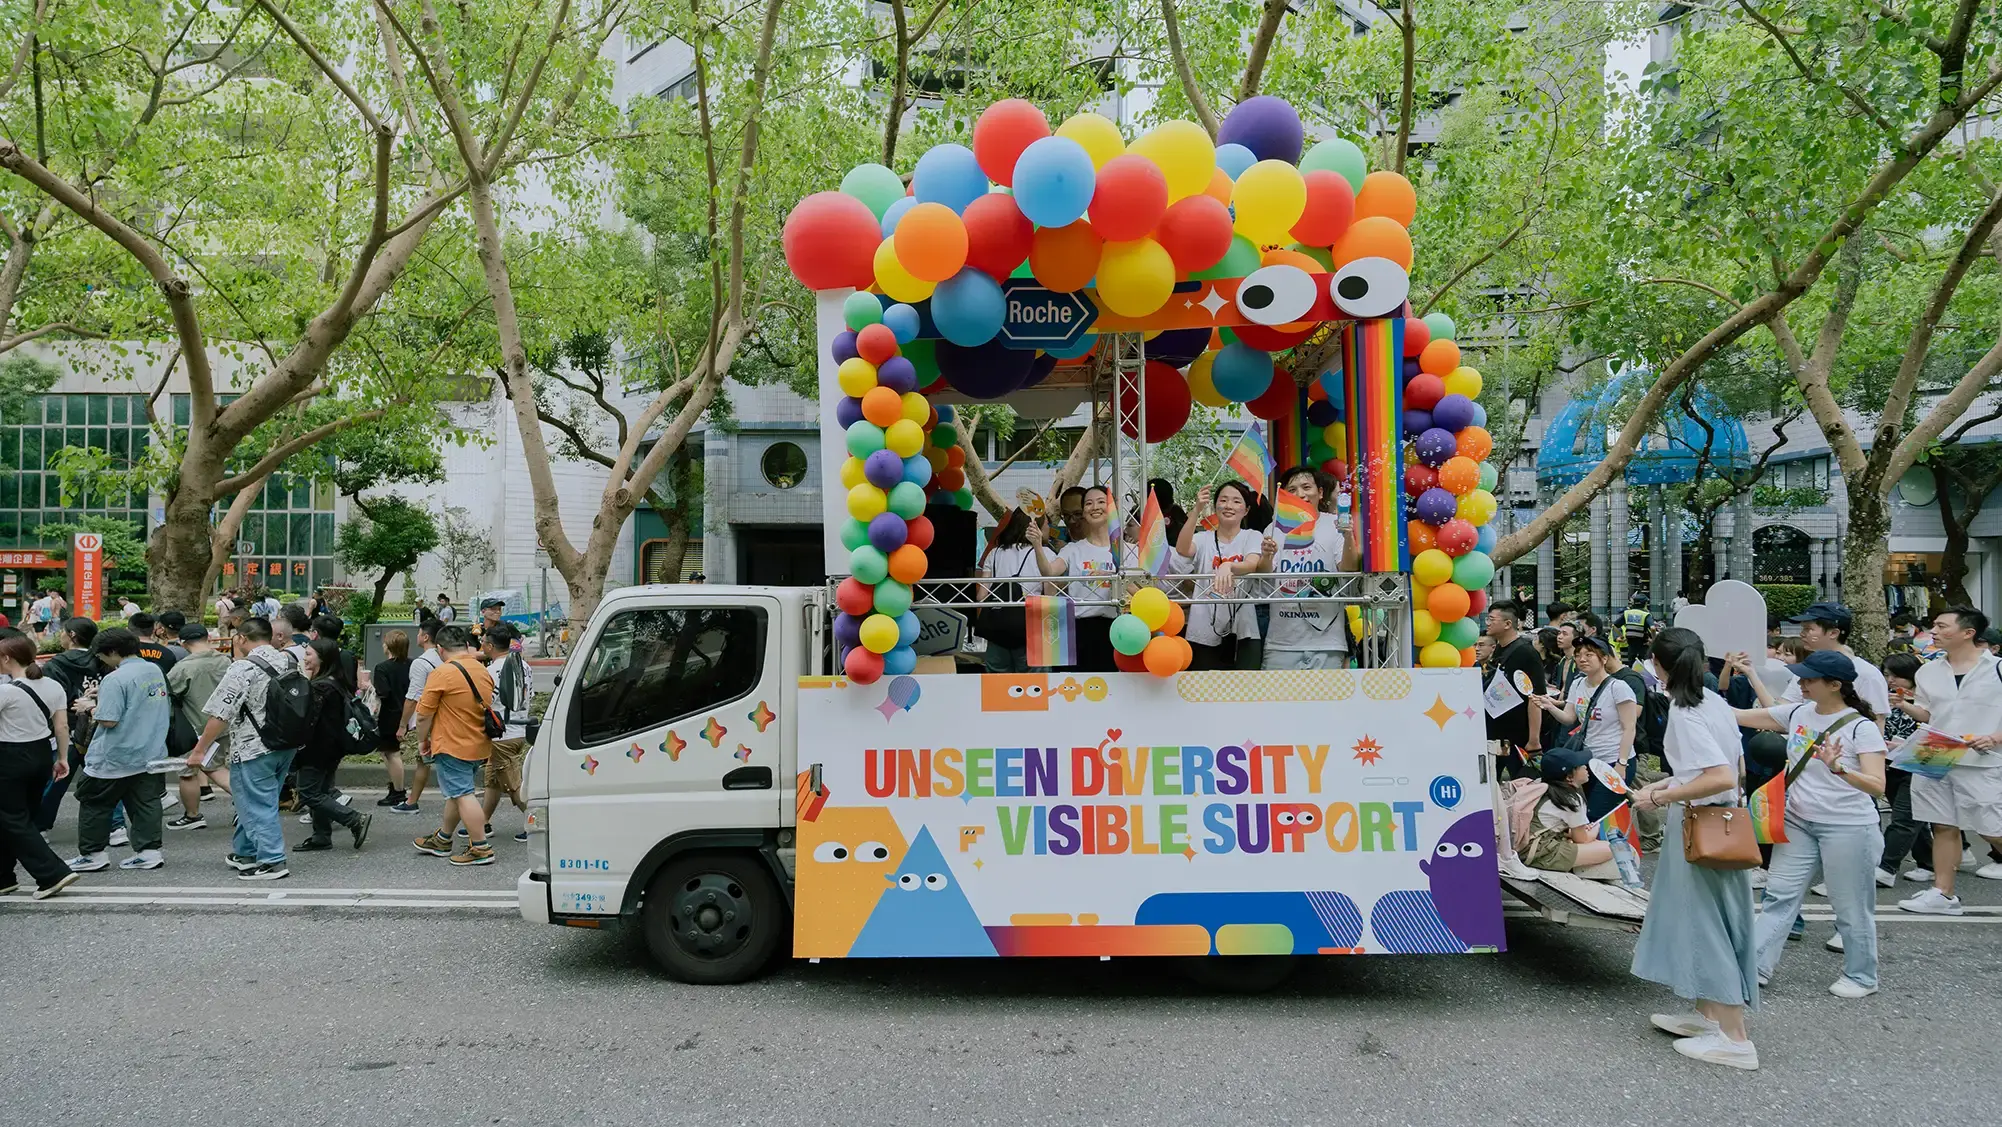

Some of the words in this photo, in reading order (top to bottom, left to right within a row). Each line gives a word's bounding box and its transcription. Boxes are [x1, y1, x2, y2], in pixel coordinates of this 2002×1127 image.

[1009, 300, 1072, 323] Roche
[1279, 611, 1320, 619] OKINAWA
[914, 620, 951, 644] che
[864, 748, 1058, 798] UNSEEN
[1441, 785, 1457, 799] Hi
[996, 804, 1190, 856] VISIBLE
[1203, 801, 1424, 854] SUPPORT
